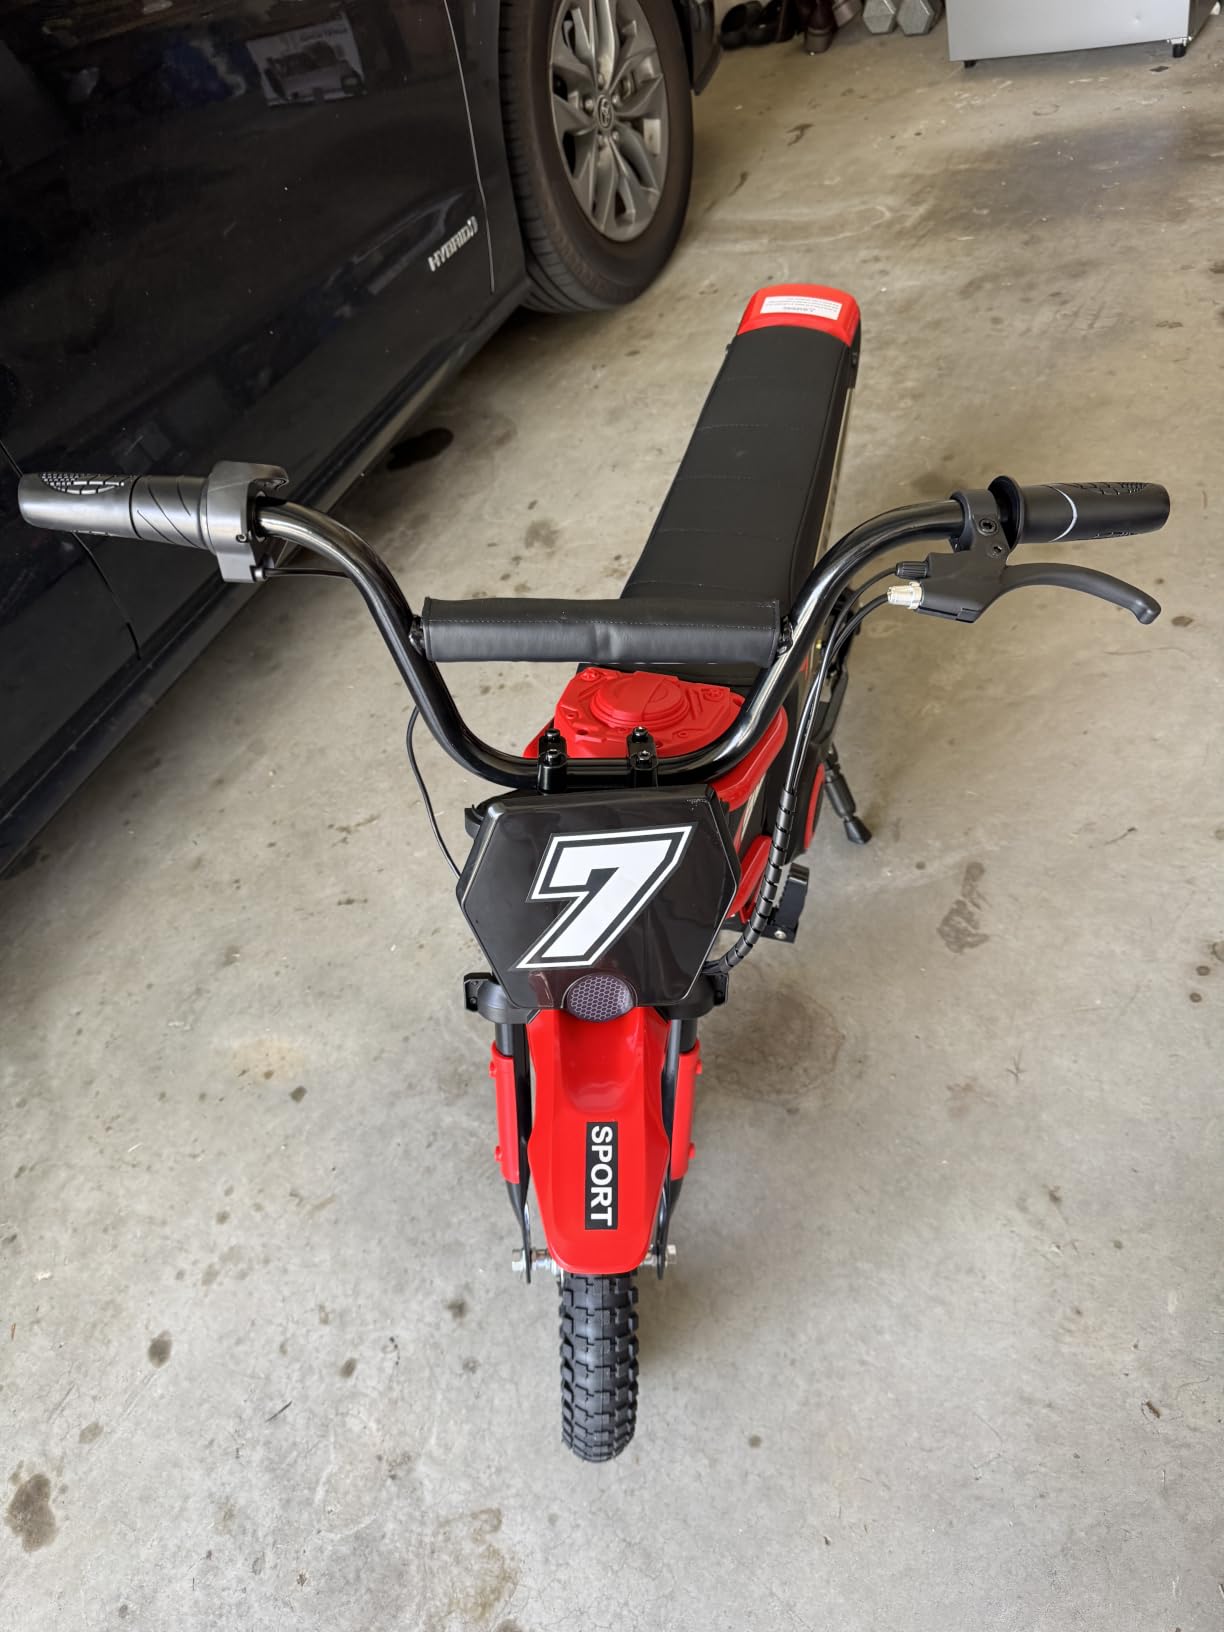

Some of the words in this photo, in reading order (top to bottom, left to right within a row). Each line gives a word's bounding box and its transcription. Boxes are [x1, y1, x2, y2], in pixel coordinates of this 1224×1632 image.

[428, 224, 472, 272] HYBRID
[515, 825, 693, 969] 7
[590, 1125, 613, 1227] SPORT
